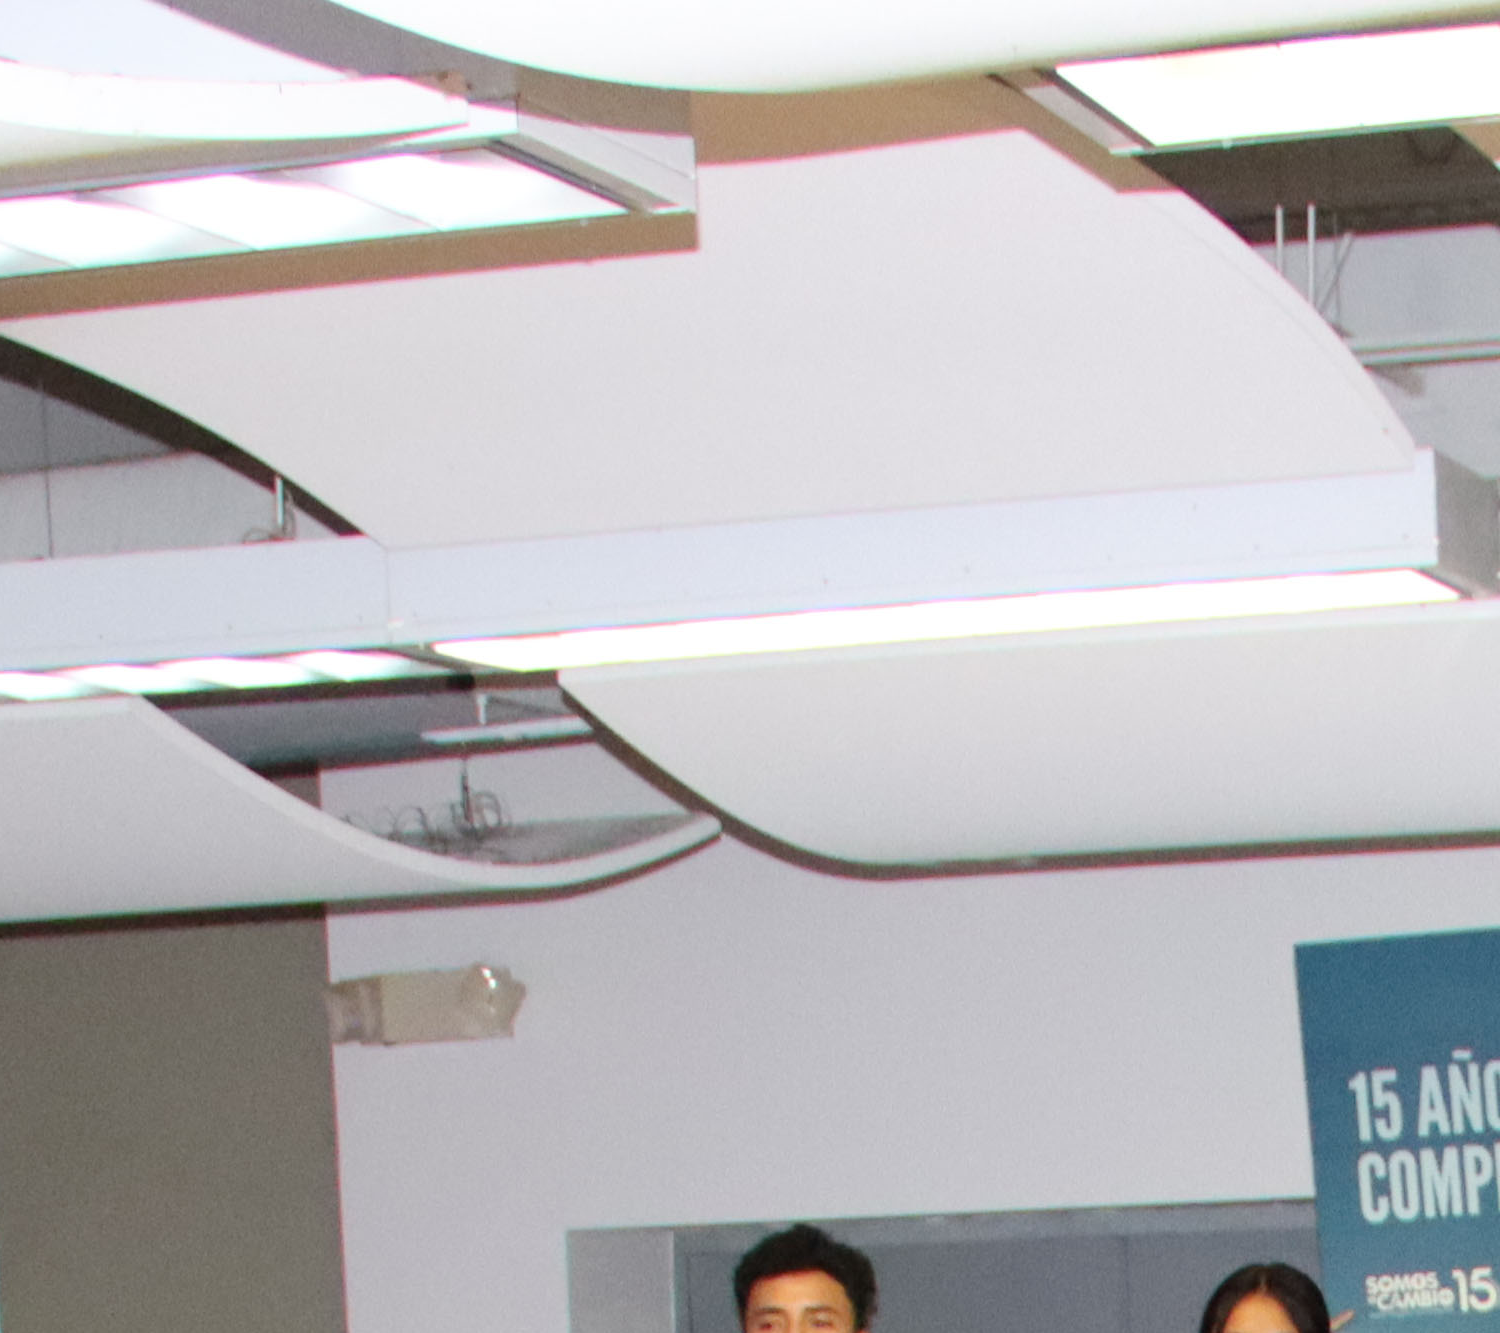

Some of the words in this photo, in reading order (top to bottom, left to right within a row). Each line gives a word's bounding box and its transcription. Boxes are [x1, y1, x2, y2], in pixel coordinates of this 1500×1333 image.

[1349, 1068, 1403, 1142] 15
[1365, 1271, 1439, 1295] SOMOS
[1451, 1266, 1498, 1313] 15
[1377, 1287, 1455, 1311] CAMBIO
